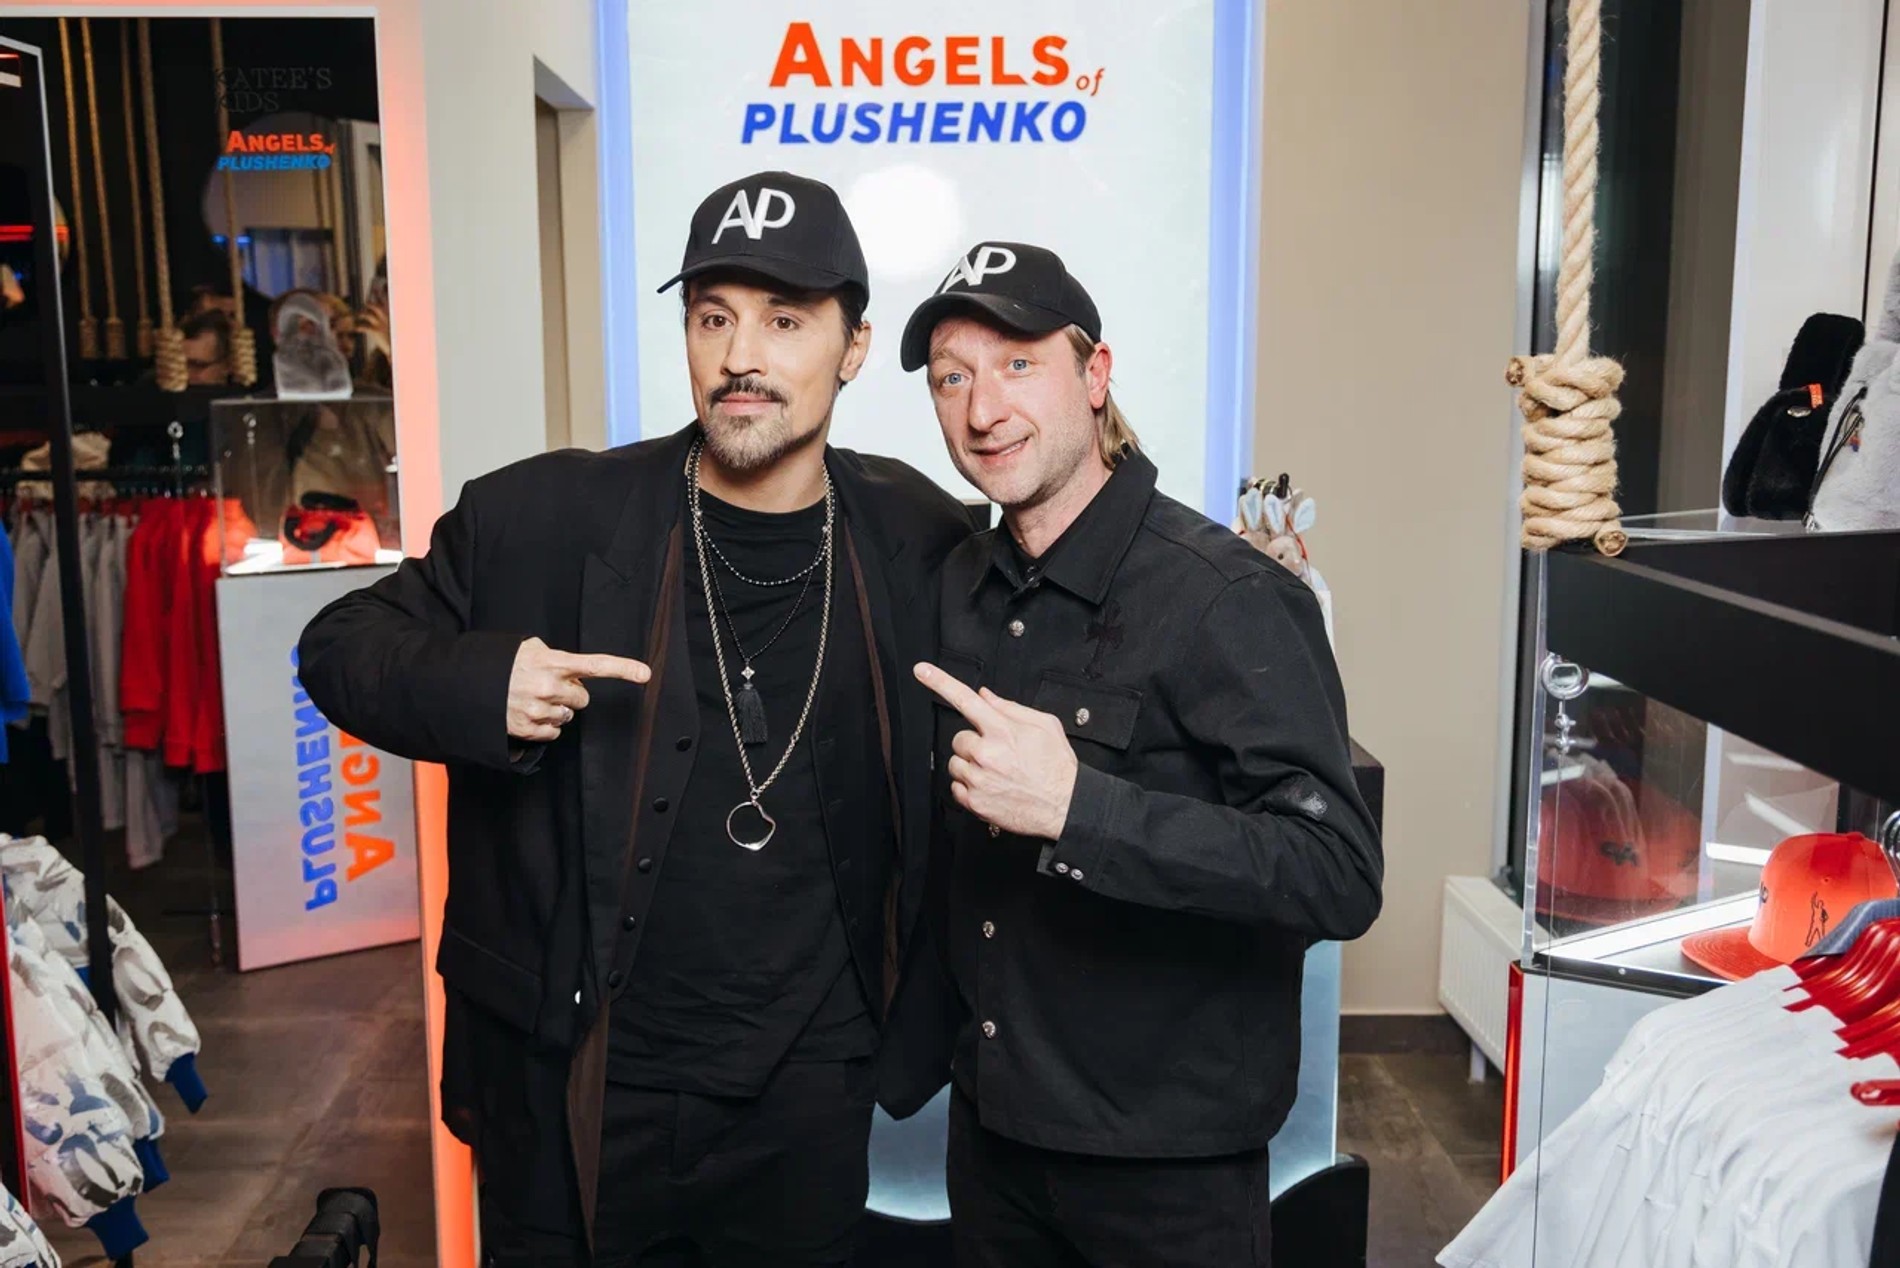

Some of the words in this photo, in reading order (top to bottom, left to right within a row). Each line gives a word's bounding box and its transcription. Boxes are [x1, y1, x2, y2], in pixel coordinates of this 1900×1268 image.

[769, 22, 1070, 88] ANGELS
[1076, 68, 1106, 96] of
[741, 101, 1087, 144] PLUSHENKO
[226, 130, 324, 153] ANGELS
[216, 153, 332, 171] PLUSHENKO
